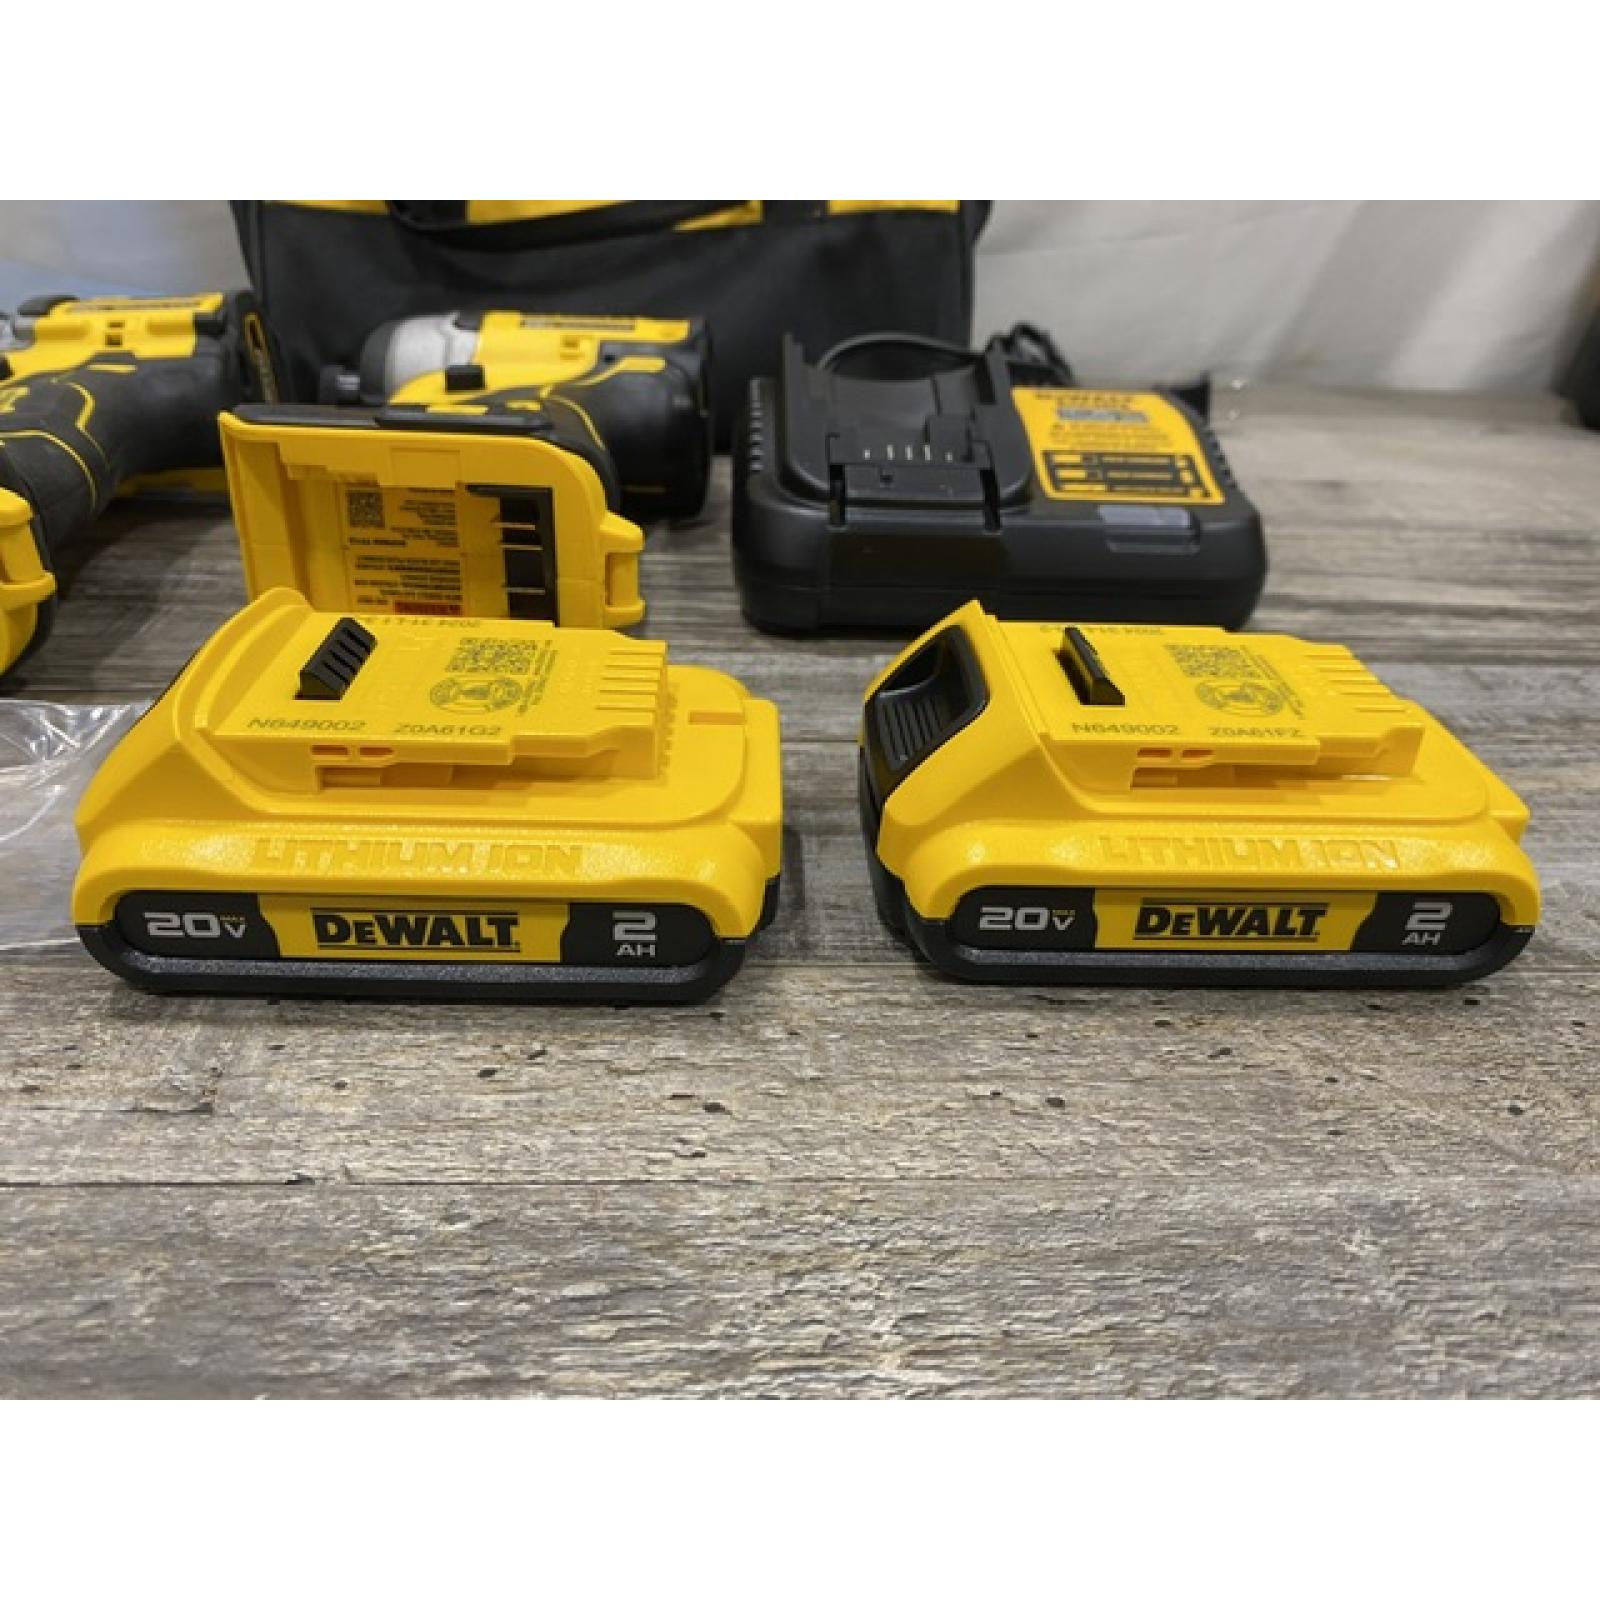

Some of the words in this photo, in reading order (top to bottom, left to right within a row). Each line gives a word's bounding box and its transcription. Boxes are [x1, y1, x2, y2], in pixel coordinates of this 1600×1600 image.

[252, 838, 482, 876] LITHIUM
[488, 843, 582, 880] ION
[1097, 835, 1304, 868] LITHIUM
[1307, 838, 1400, 871] ION
[612, 911, 657, 941] 2
[1404, 902, 1453, 930] 2
[616, 944, 656, 956] AH
